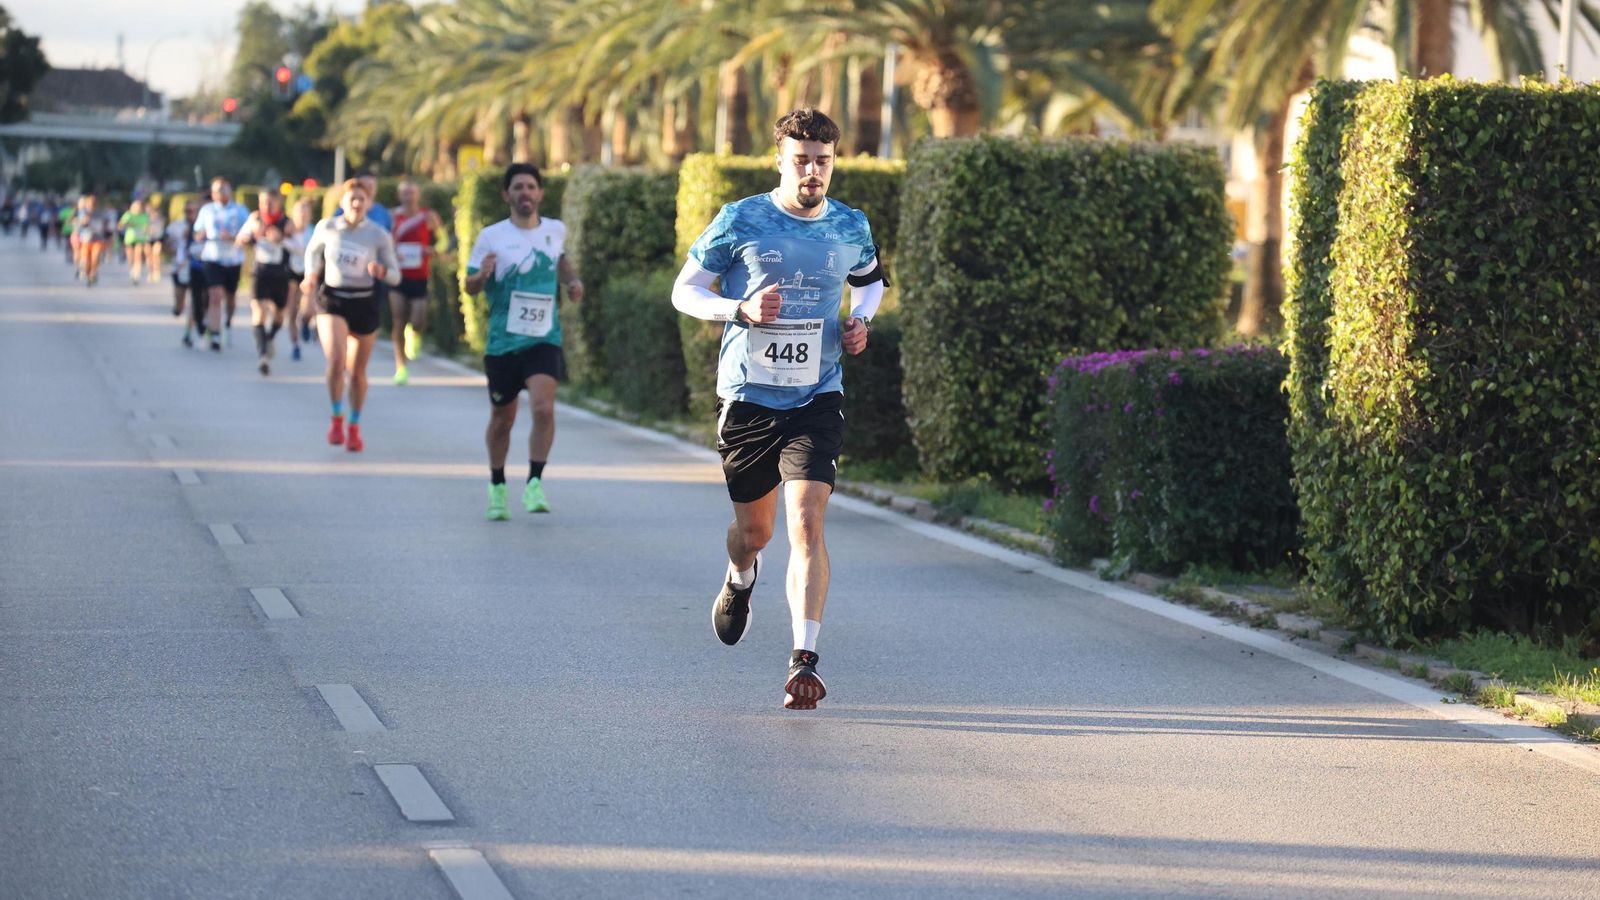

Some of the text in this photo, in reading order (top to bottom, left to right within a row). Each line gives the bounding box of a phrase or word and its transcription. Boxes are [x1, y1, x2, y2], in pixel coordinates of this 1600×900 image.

[336, 253, 358, 266] 262
[753, 255, 783, 263] Electrolit
[519, 307, 545, 322] 259
[764, 342, 809, 364] 448
